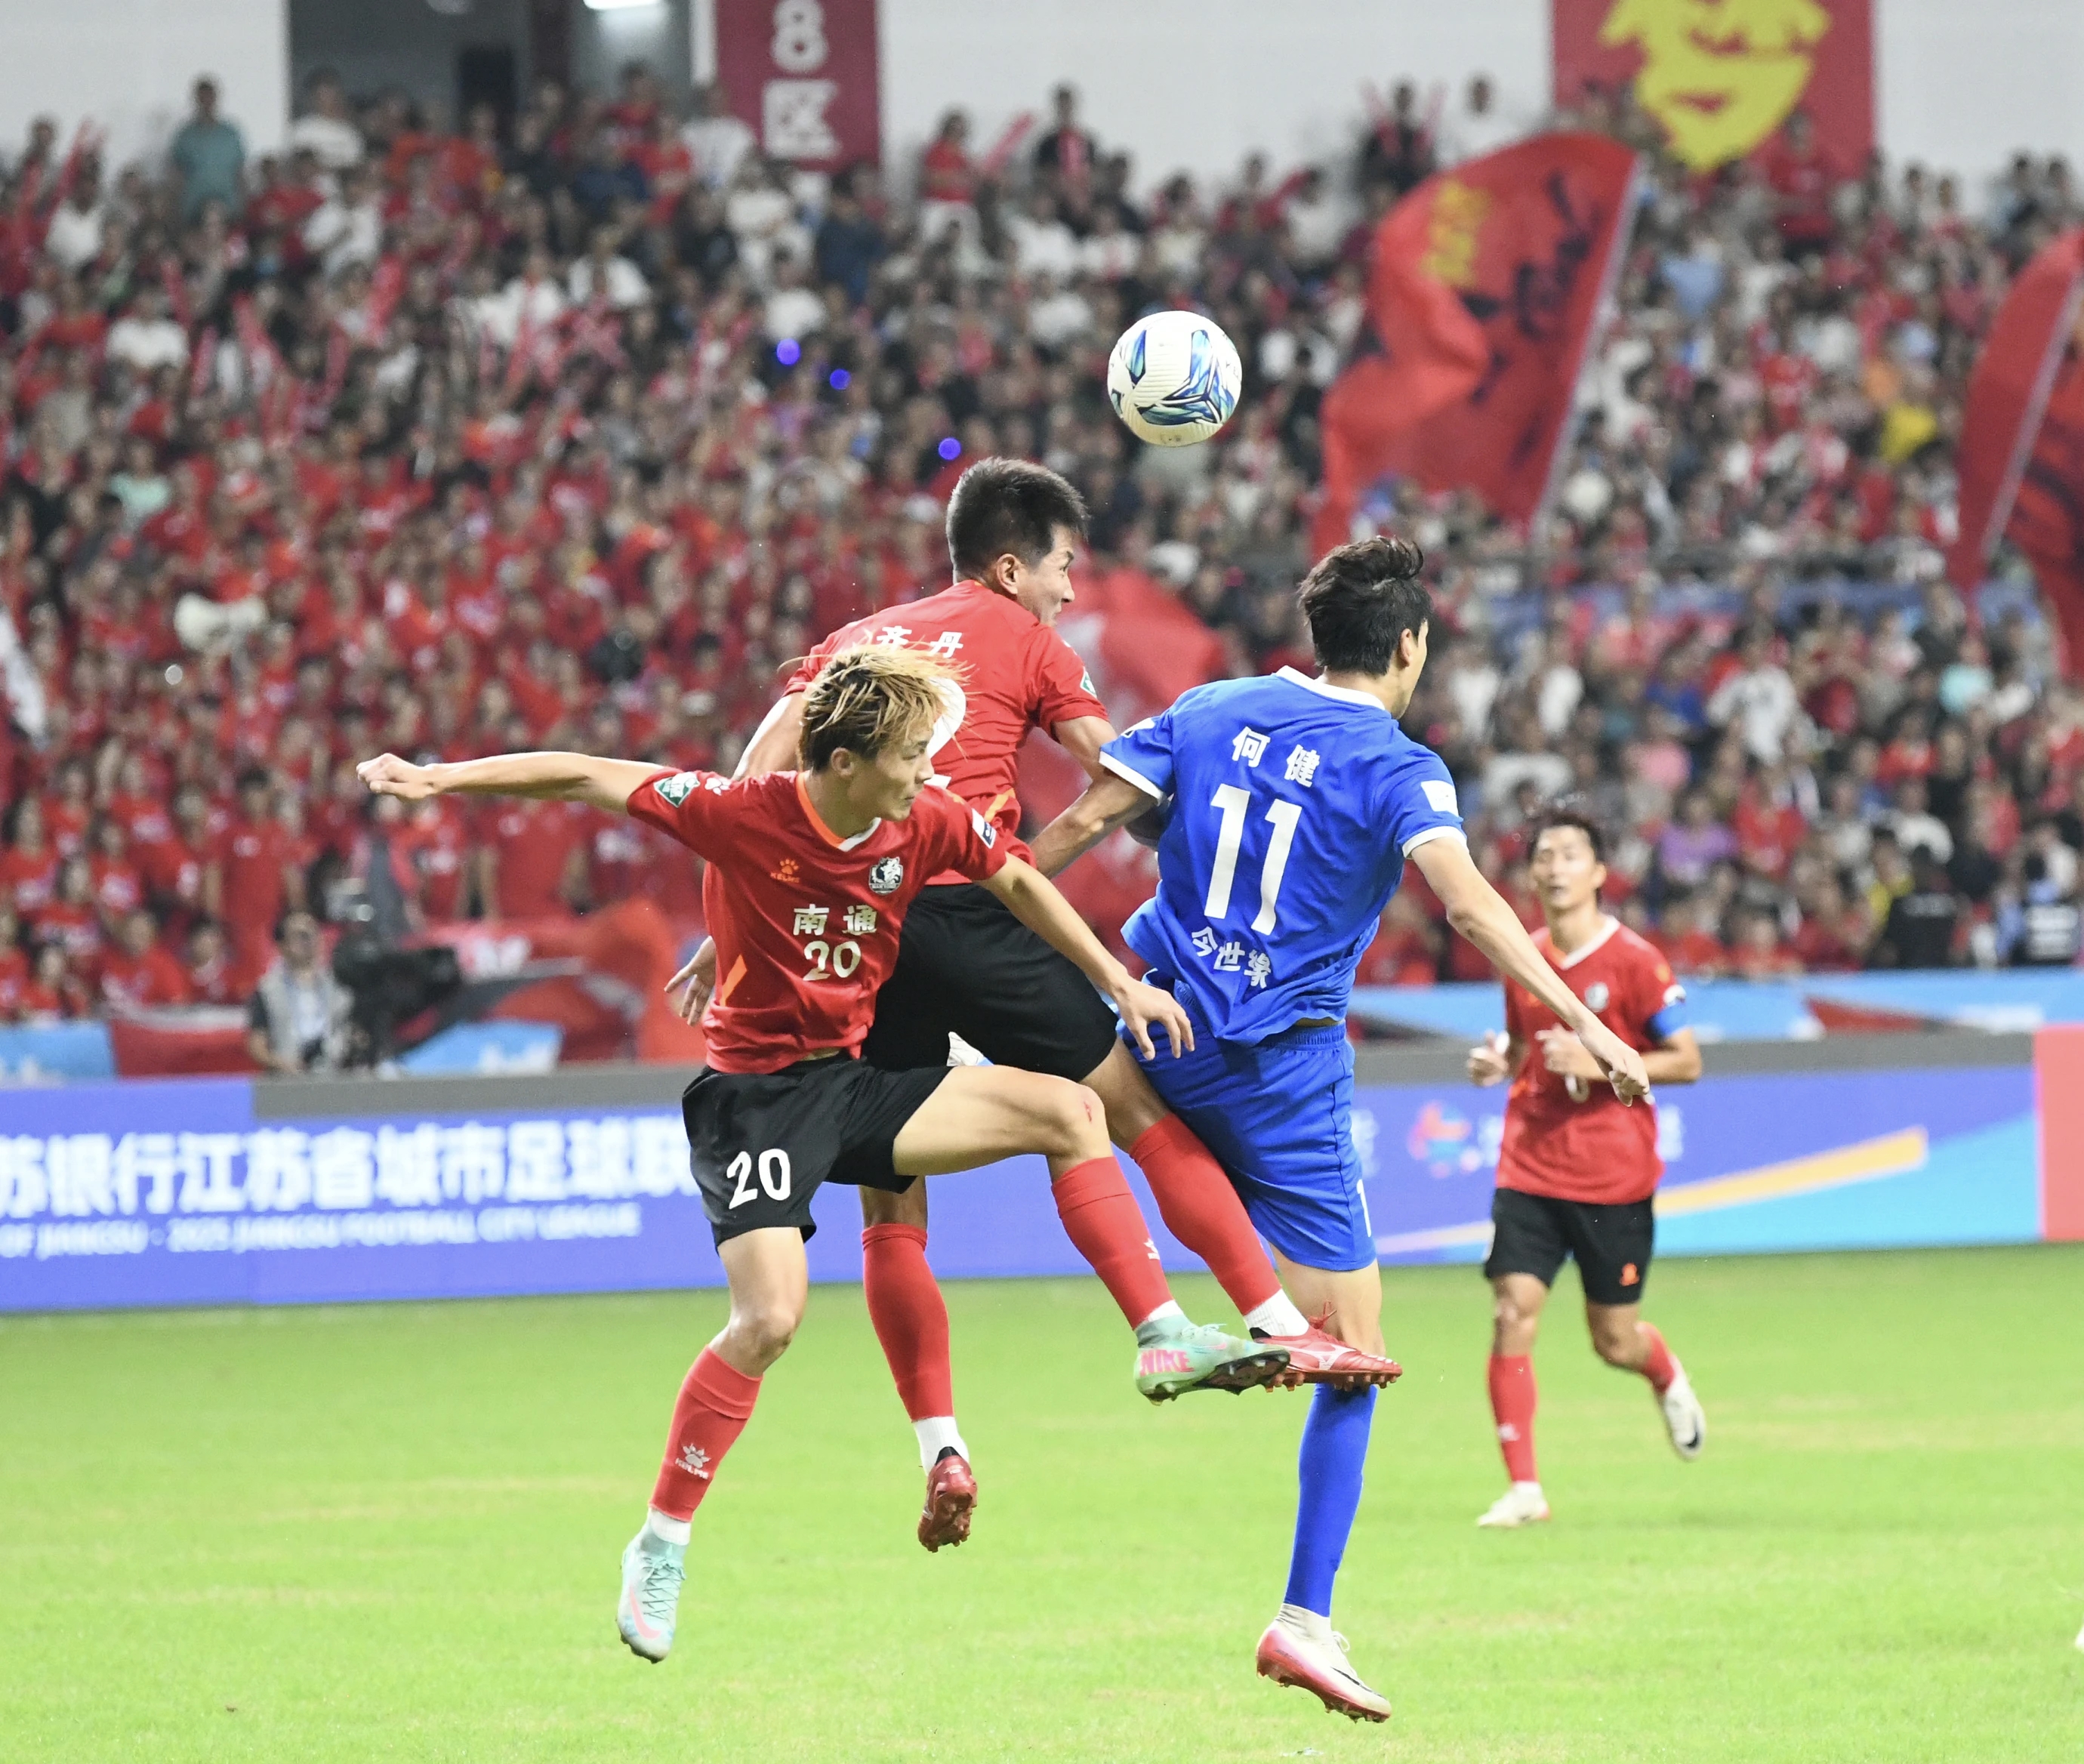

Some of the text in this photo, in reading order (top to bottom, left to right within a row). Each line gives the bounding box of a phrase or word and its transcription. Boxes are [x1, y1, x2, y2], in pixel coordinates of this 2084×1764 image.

[1232, 726, 1320, 788] 何健
[1204, 783, 1302, 936] 11
[793, 903, 877, 936] 南通
[803, 941, 862, 981] 20
[726, 1148, 791, 1210] 20
[1139, 1349, 1195, 1377] NIKE
